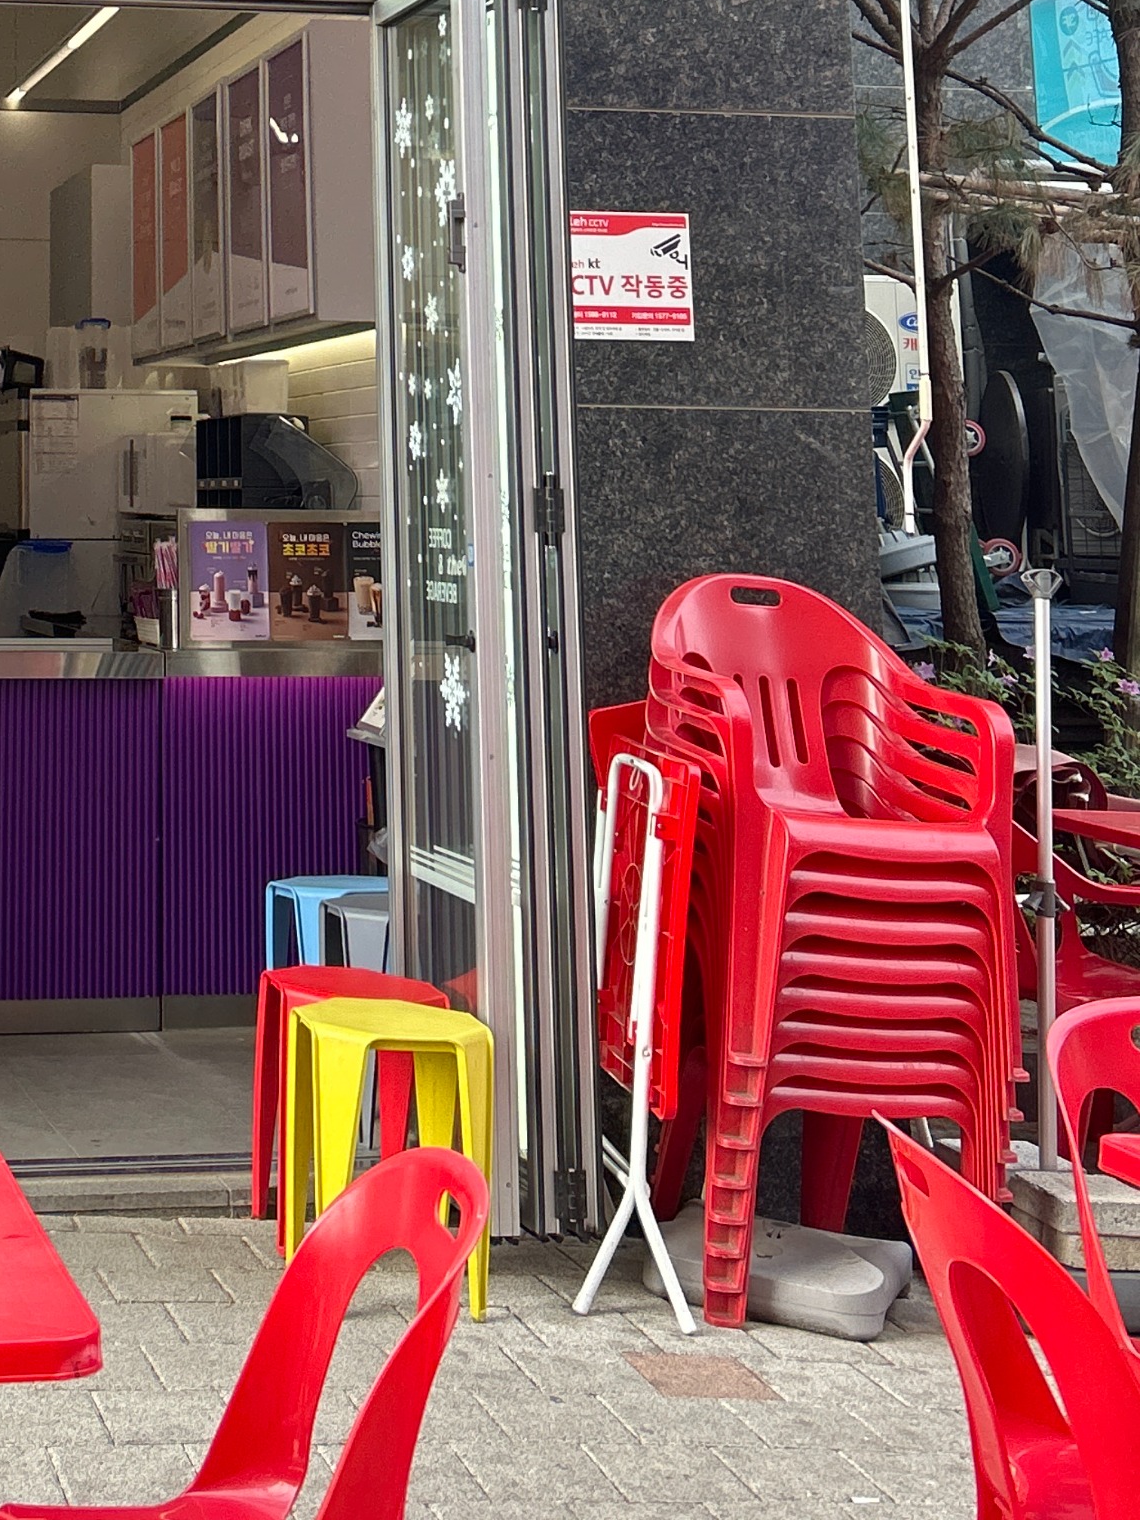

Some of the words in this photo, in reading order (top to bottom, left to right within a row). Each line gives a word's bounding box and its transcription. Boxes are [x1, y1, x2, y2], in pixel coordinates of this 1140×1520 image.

[588, 218, 609, 228] CCTV
[588, 258, 601, 269] kt
[621, 274, 689, 299] 작동중
[282, 543, 330, 556] 초코초코
